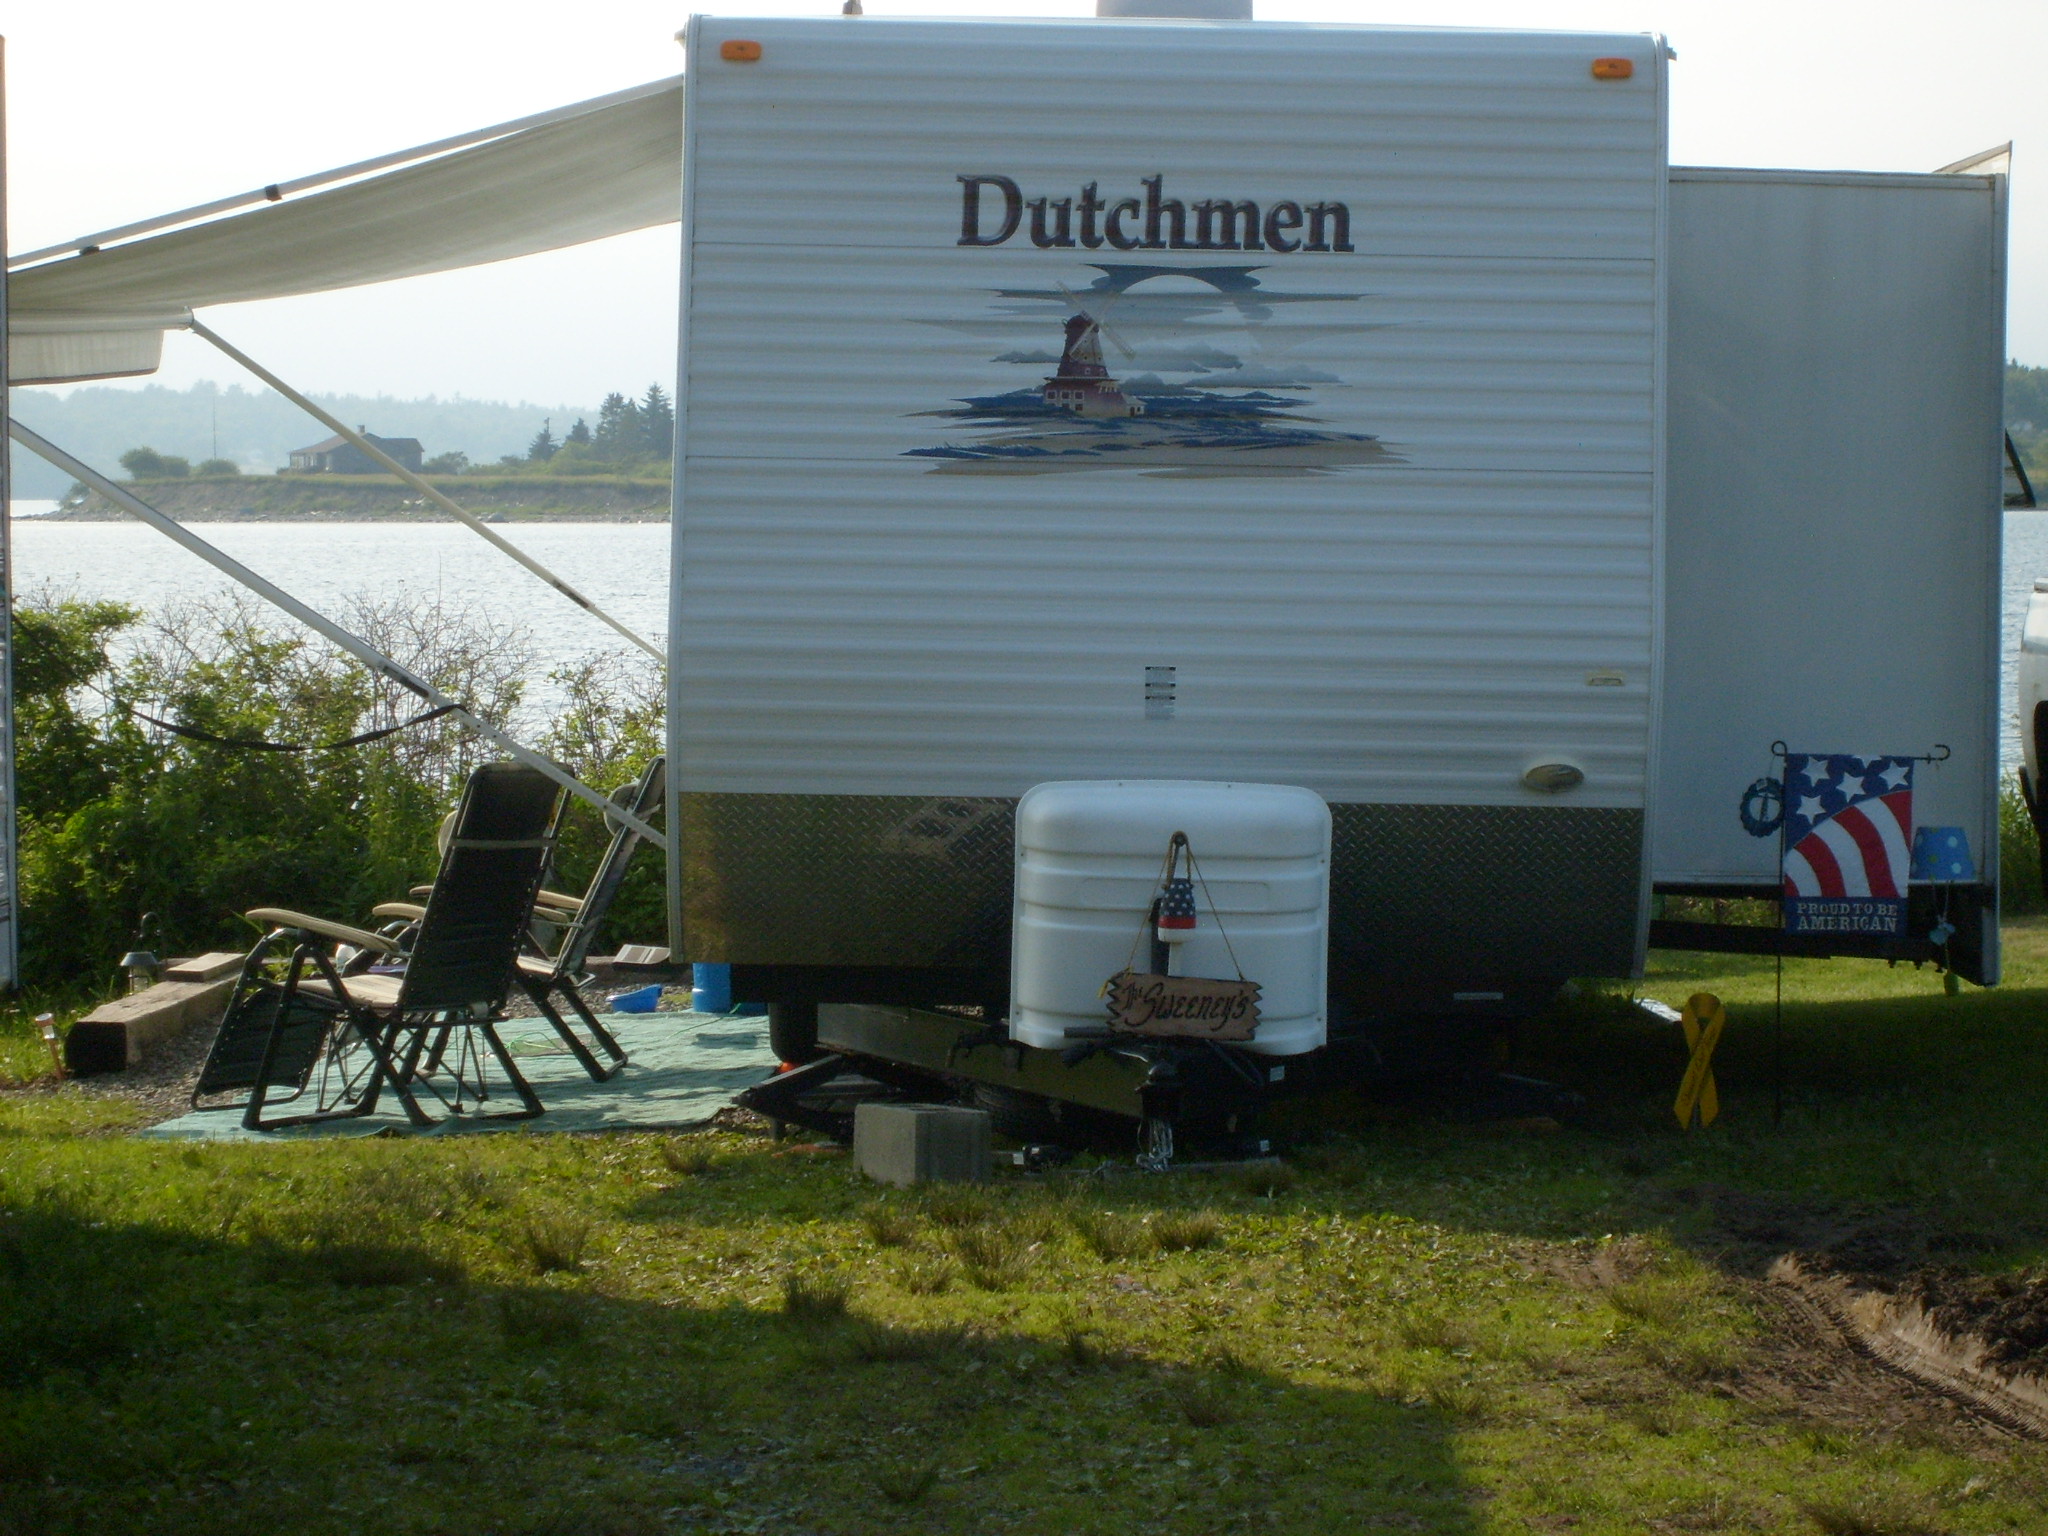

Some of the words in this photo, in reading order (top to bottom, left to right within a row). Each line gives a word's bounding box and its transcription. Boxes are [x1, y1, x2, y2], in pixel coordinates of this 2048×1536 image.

[956, 172, 1355, 254] Dutchmen
[1797, 902, 1850, 914] PROUD
[1853, 903, 1873, 914] TO
[1878, 904, 1898, 916] BE
[1797, 916, 1898, 932] AMERICAN
